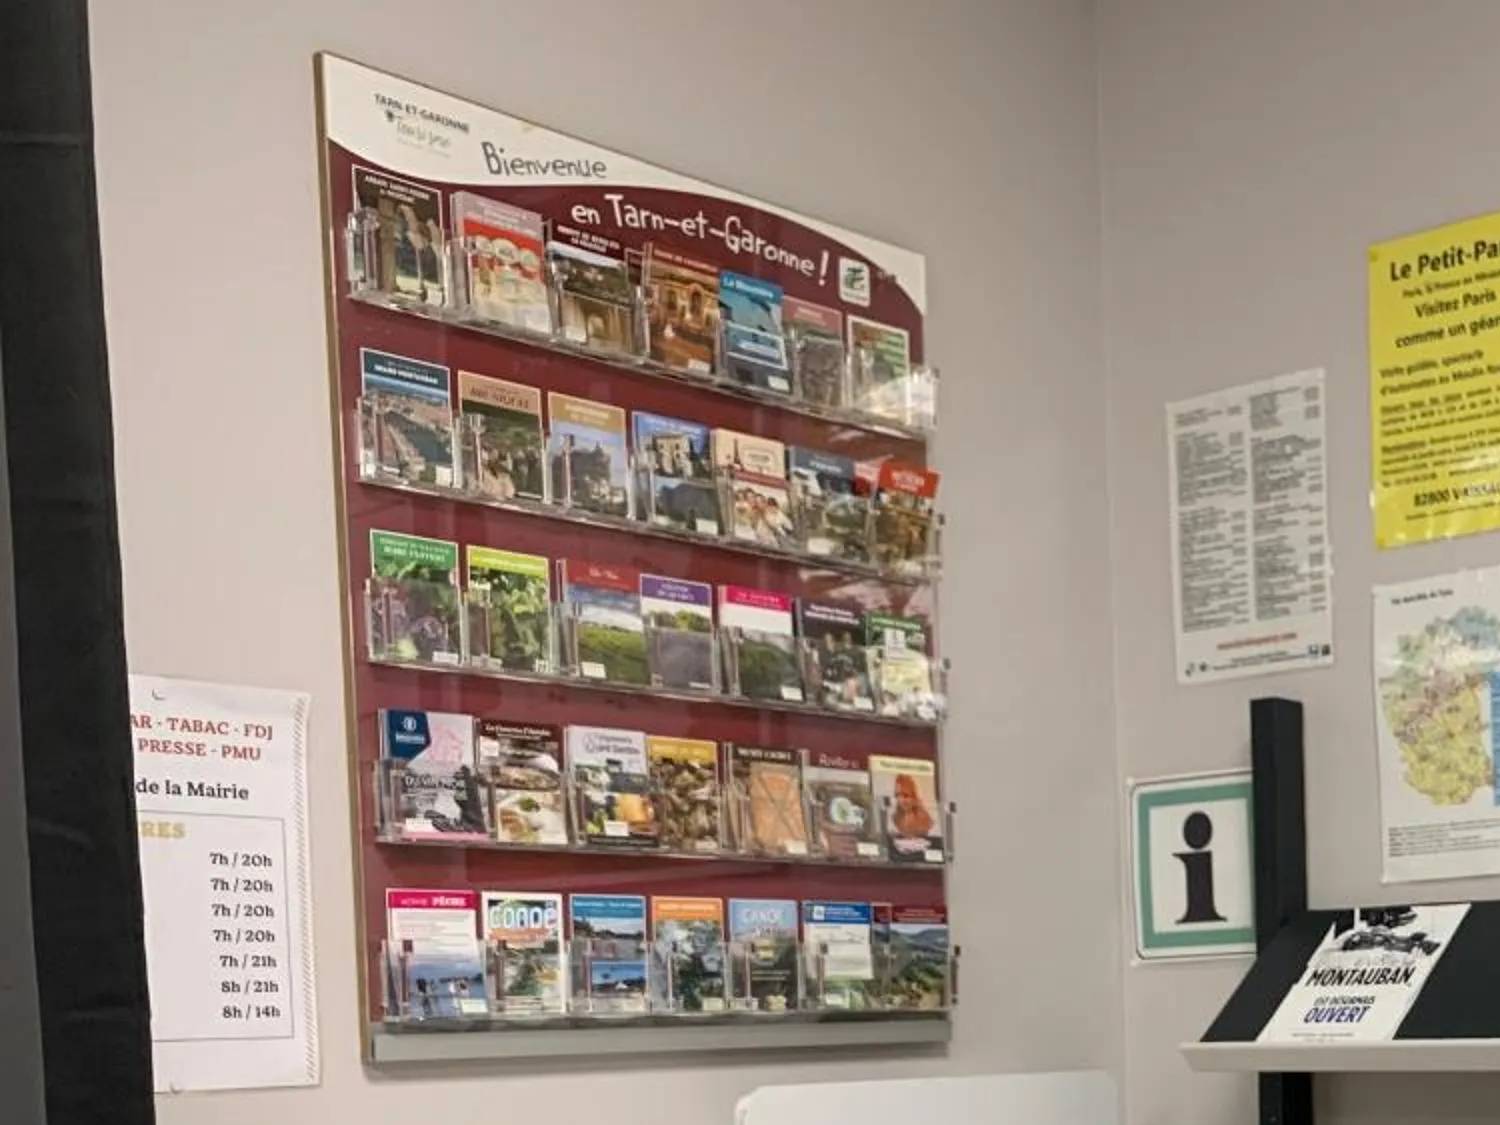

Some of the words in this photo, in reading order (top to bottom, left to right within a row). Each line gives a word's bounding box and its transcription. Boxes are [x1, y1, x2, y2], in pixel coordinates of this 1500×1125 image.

[481, 141, 607, 179] Bienvenue
[571, 203, 600, 225] en
[1390, 261, 1412, 282] Le
[1462, 289, 1497, 309] Paris
[166, 717, 229, 735] TABAC
[243, 723, 273, 741] FDJ
[137, 738, 207, 757] PRESSE
[221, 745, 261, 761] PMU
[135, 778, 160, 795] de
[165, 780, 182, 796] la
[187, 782, 250, 801] Mairie
[242, 853, 273, 867] 20h
[243, 879, 274, 893] 20h
[244, 904, 275, 918] 20h
[245, 930, 276, 943] 20h
[251, 955, 278, 969] 21h
[1306, 966, 1416, 987] MONTAUBAN
[253, 981, 280, 993] 21h
[255, 1006, 281, 1019] 14h
[1303, 1005, 1371, 1024] OUVERT
